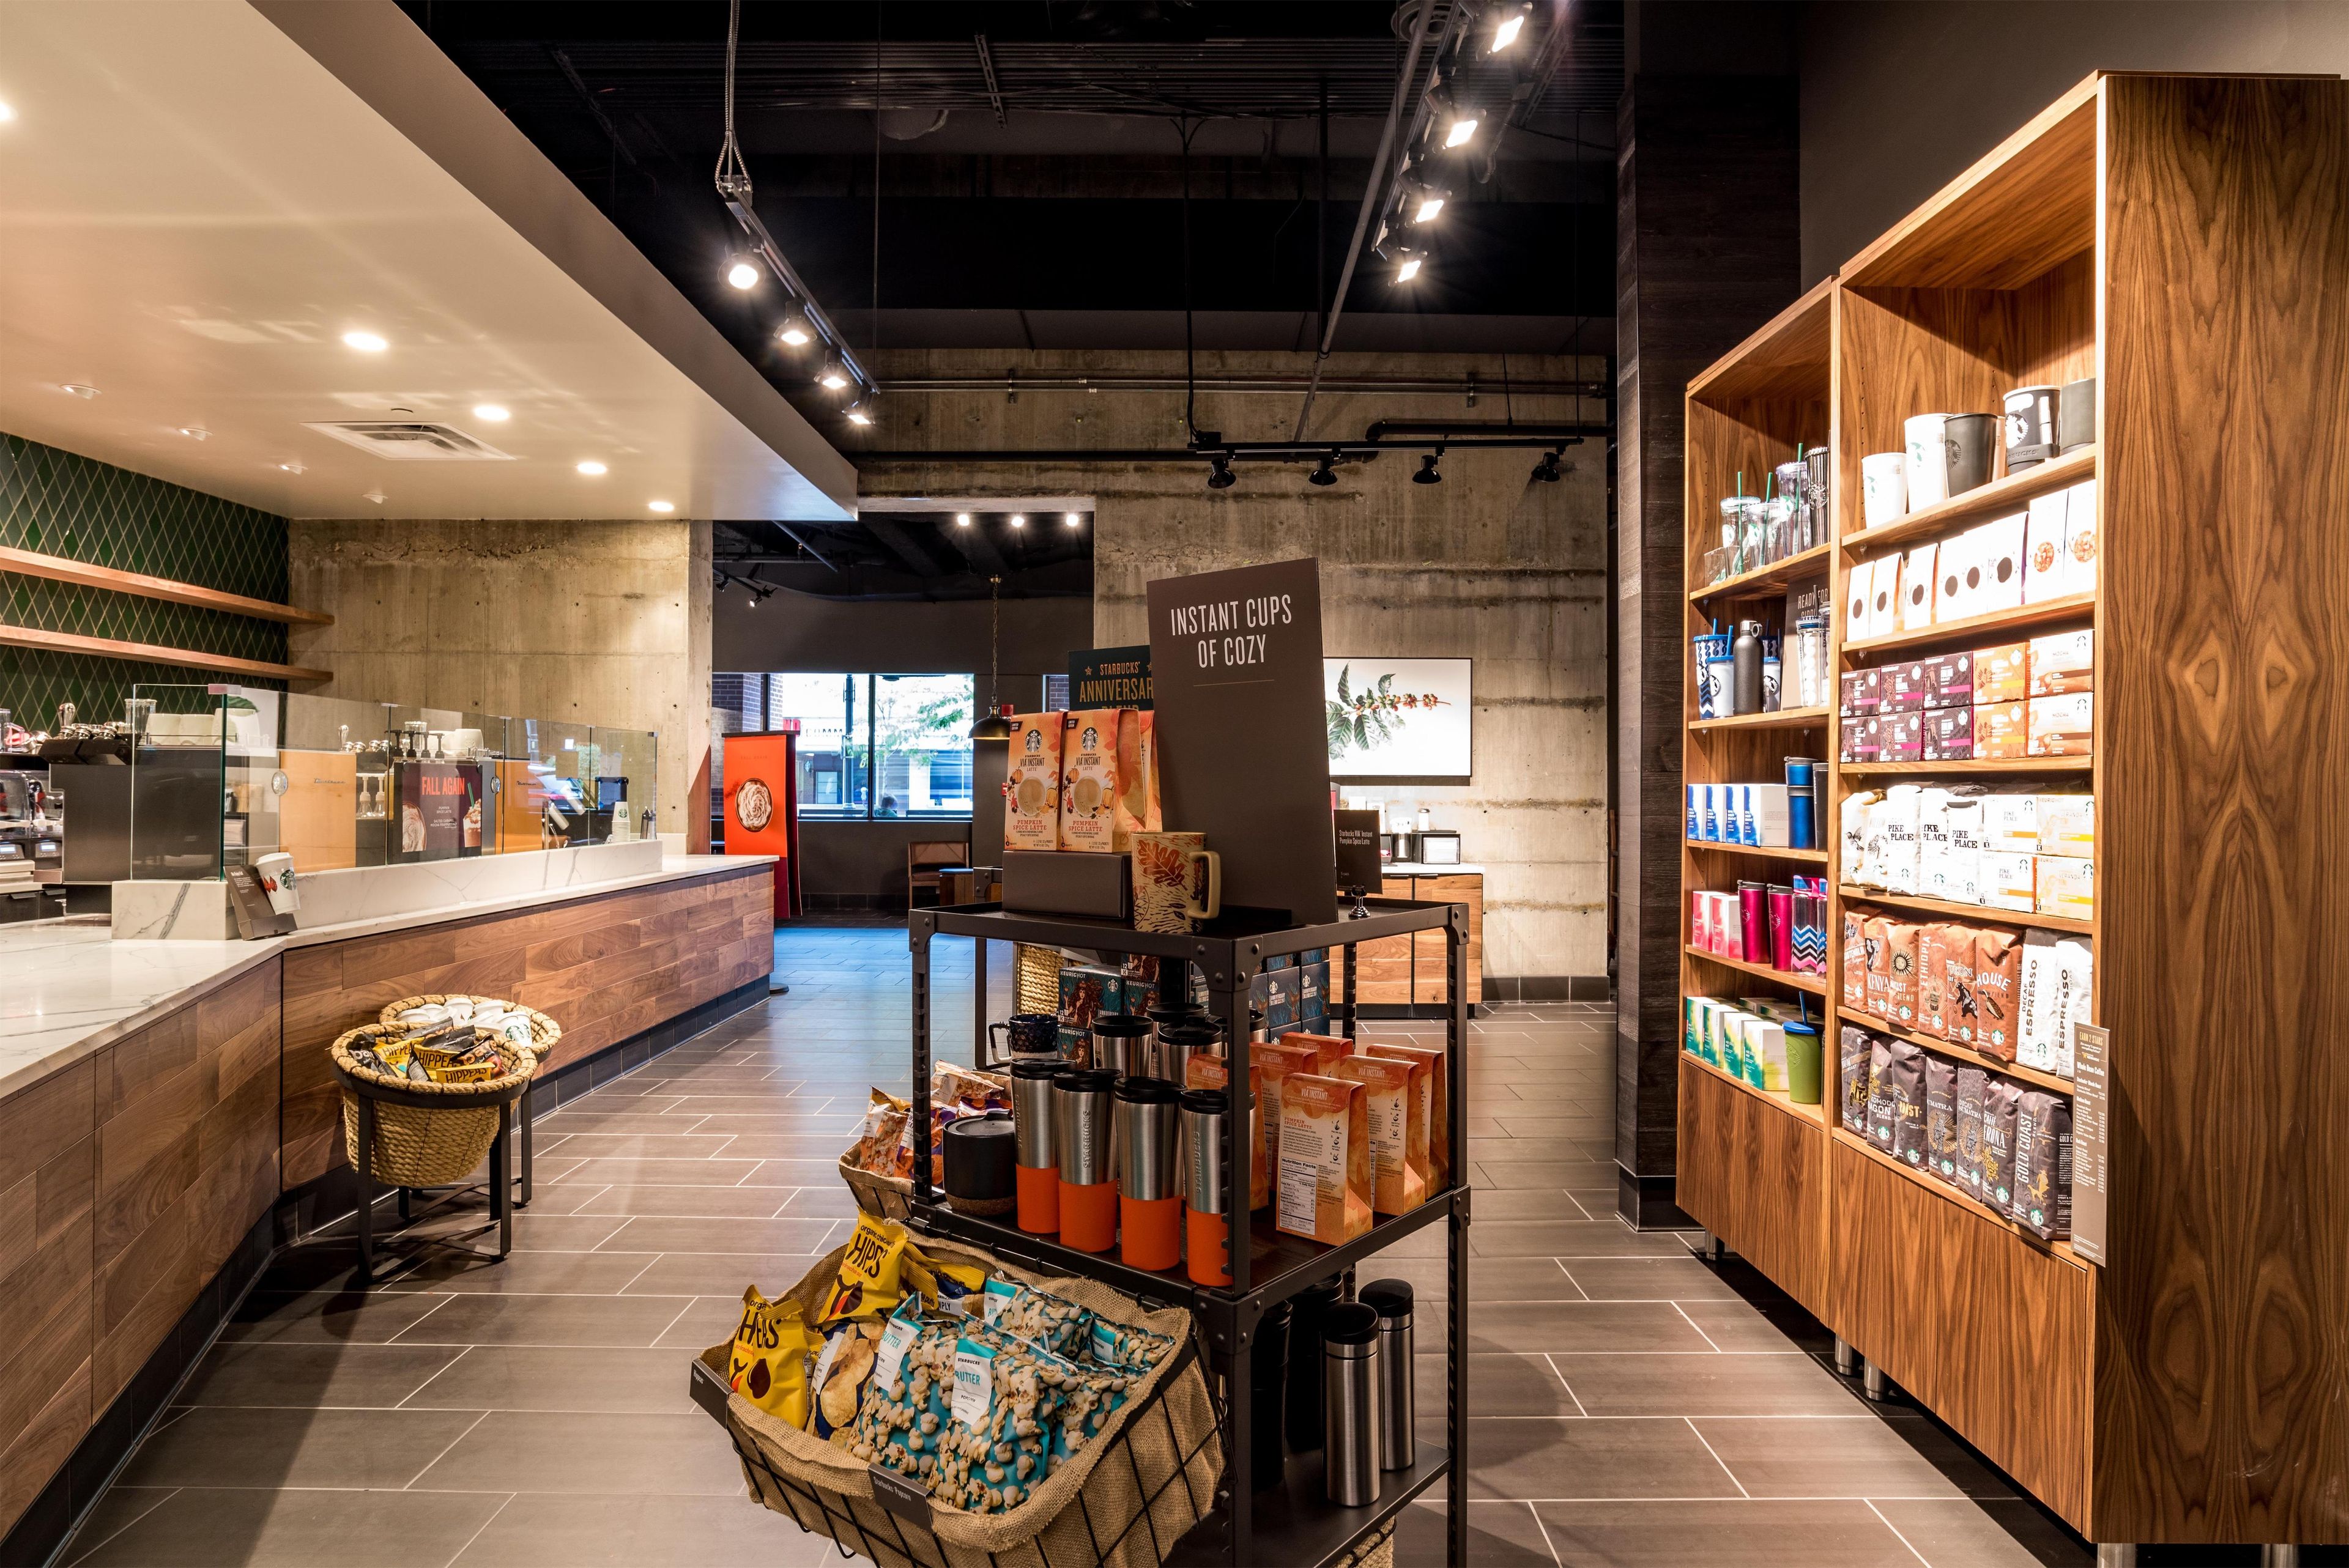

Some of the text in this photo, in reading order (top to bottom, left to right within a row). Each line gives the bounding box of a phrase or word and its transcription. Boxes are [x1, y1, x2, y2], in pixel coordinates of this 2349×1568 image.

[1798, 591, 1816, 609] READY
[1171, 594, 1292, 635] INSTANT CUPS
[1198, 634, 1266, 668] OF COZY
[1080, 677, 1154, 702] ANNIVERSAR
[1027, 758, 1044, 766] INSTANT
[1083, 756, 1100, 765] INSTANT
[422, 777, 465, 795] FALL AGAIN
[1952, 830, 1969, 838] PIKE
[1954, 840, 1978, 848] PLACE
[1920, 936, 1931, 986] ETHIOPIA
[1868, 973, 1890, 992] KENYA
[1977, 972, 2011, 991] HOUSE
[2026, 960, 2038, 1036] ESPRESSO
[2058, 969, 2069, 1049] ESPRESSO
[2080, 1032, 2088, 1041] EARN
[2092, 1035, 2103, 1046] STARS
[1267, 1054, 1283, 1064] INSTANT
[1209, 1069, 1223, 1079] INSTANT
[1367, 1068, 1385, 1079] INSTANT
[2095, 1067, 2104, 1076] Coffee
[1309, 1089, 1328, 1101] INSTANT
[1927, 1099, 1953, 1111] UMATRA
[1984, 1125, 2005, 1148] ERONA
[2018, 1112, 2032, 1183] GOLD COAST
[883, 1331, 902, 1349] BUTTER
[955, 1370, 980, 1386] BUTTER
[874, 1476, 911, 1501] Starbucks Popcorn
